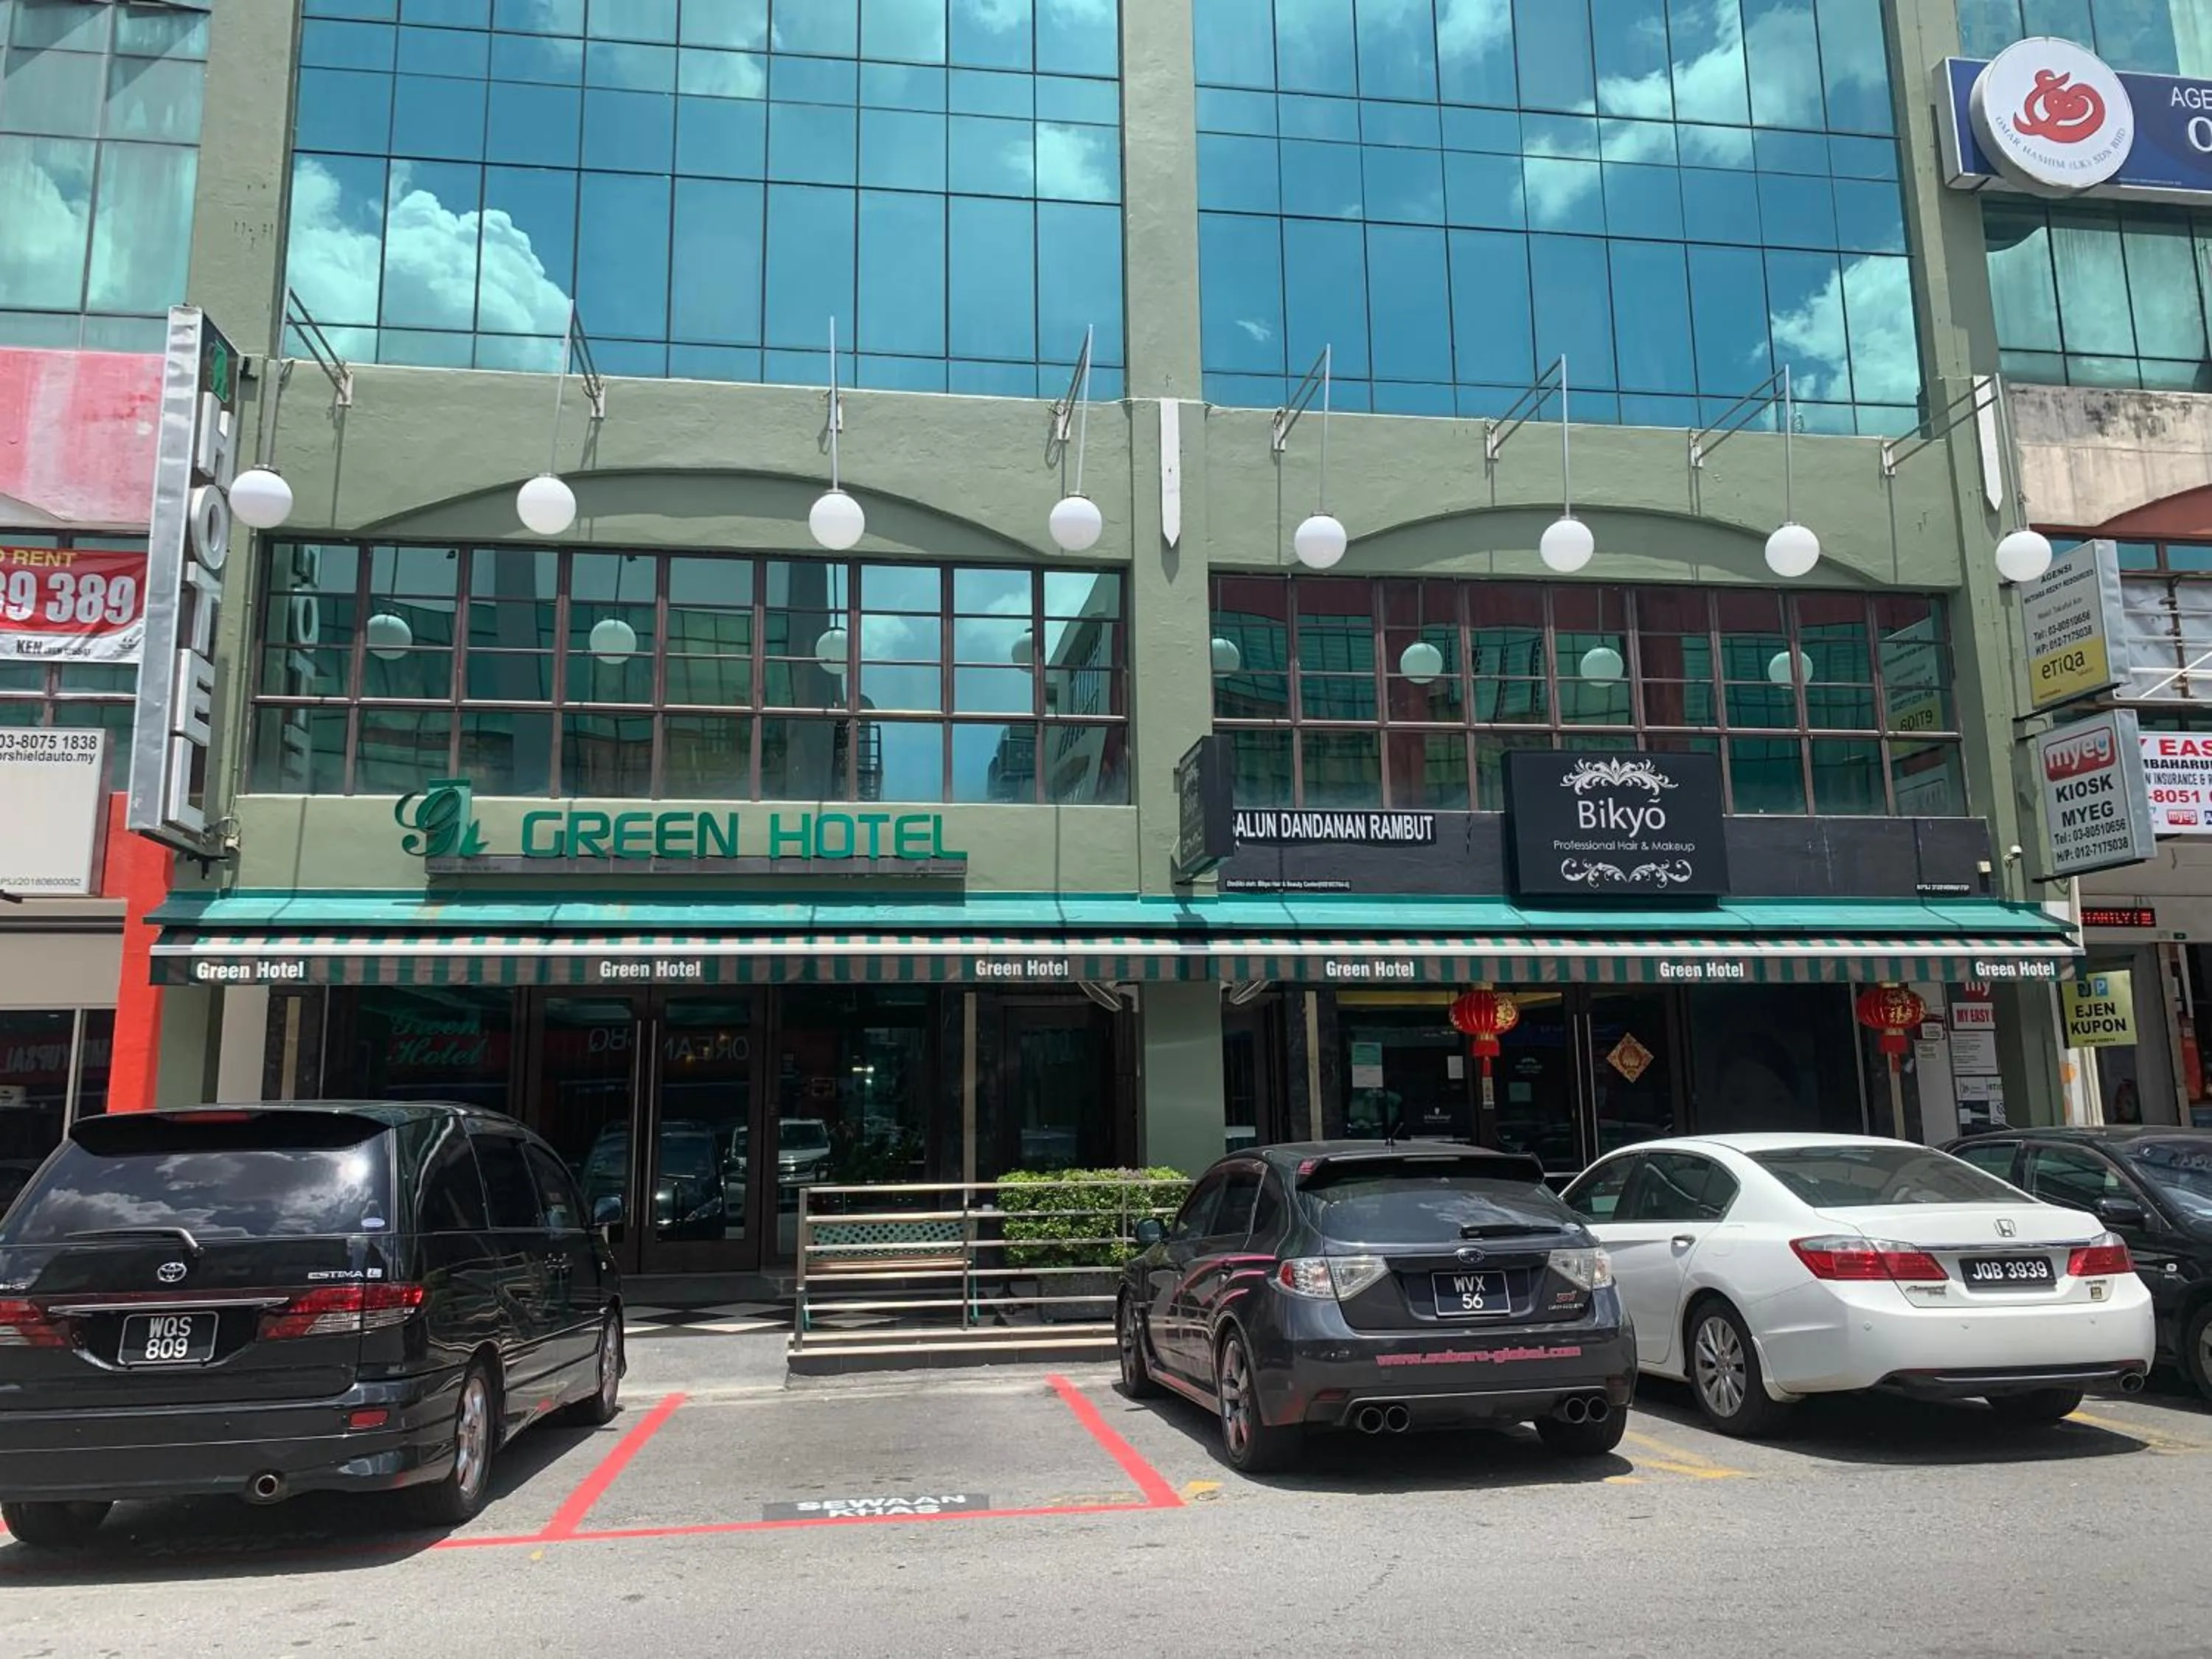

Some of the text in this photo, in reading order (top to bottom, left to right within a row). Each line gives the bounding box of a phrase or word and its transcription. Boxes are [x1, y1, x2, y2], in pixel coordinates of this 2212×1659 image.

[13, 549, 77, 567] RENT
[2040, 563, 2073, 584] AGENSI
[46, 573, 136, 625] 389
[170, 391, 234, 836] HOTEL
[63, 735, 97, 750] 1838
[2154, 773, 2198, 785] INSURANCE
[2056, 774, 2114, 803] KIOSK
[2062, 800, 2114, 828] MYEG
[1281, 813, 1365, 839] DANDANAN
[1370, 815, 1433, 840] RAMBUT
[521, 811, 968, 860] GREEN HOTEL
[1554, 840, 1695, 853] Professional Hair & Makeup
[197, 961, 305, 979] Green Hotel
[599, 961, 700, 977] Green Hotel
[975, 960, 1068, 976] Green Hotel
[1326, 961, 1414, 977] Green Hotel
[1660, 961, 1744, 977] Green Hotel
[1975, 961, 2056, 976] Green Hotel
[1971, 1008, 1989, 1023] EASY
[2075, 1002, 2115, 1018] EJEN
[2070, 1018, 2127, 1035] KUPON
[1972, 1260, 2048, 1280] JQB 3939
[1453, 1276, 1486, 1292] WVX
[1462, 1293, 1484, 1310] 56
[149, 1316, 192, 1338] WQS
[145, 1338, 188, 1360] 809
[797, 1495, 966, 1511] SEWAAN
[829, 1505, 941, 1518] KHAS
